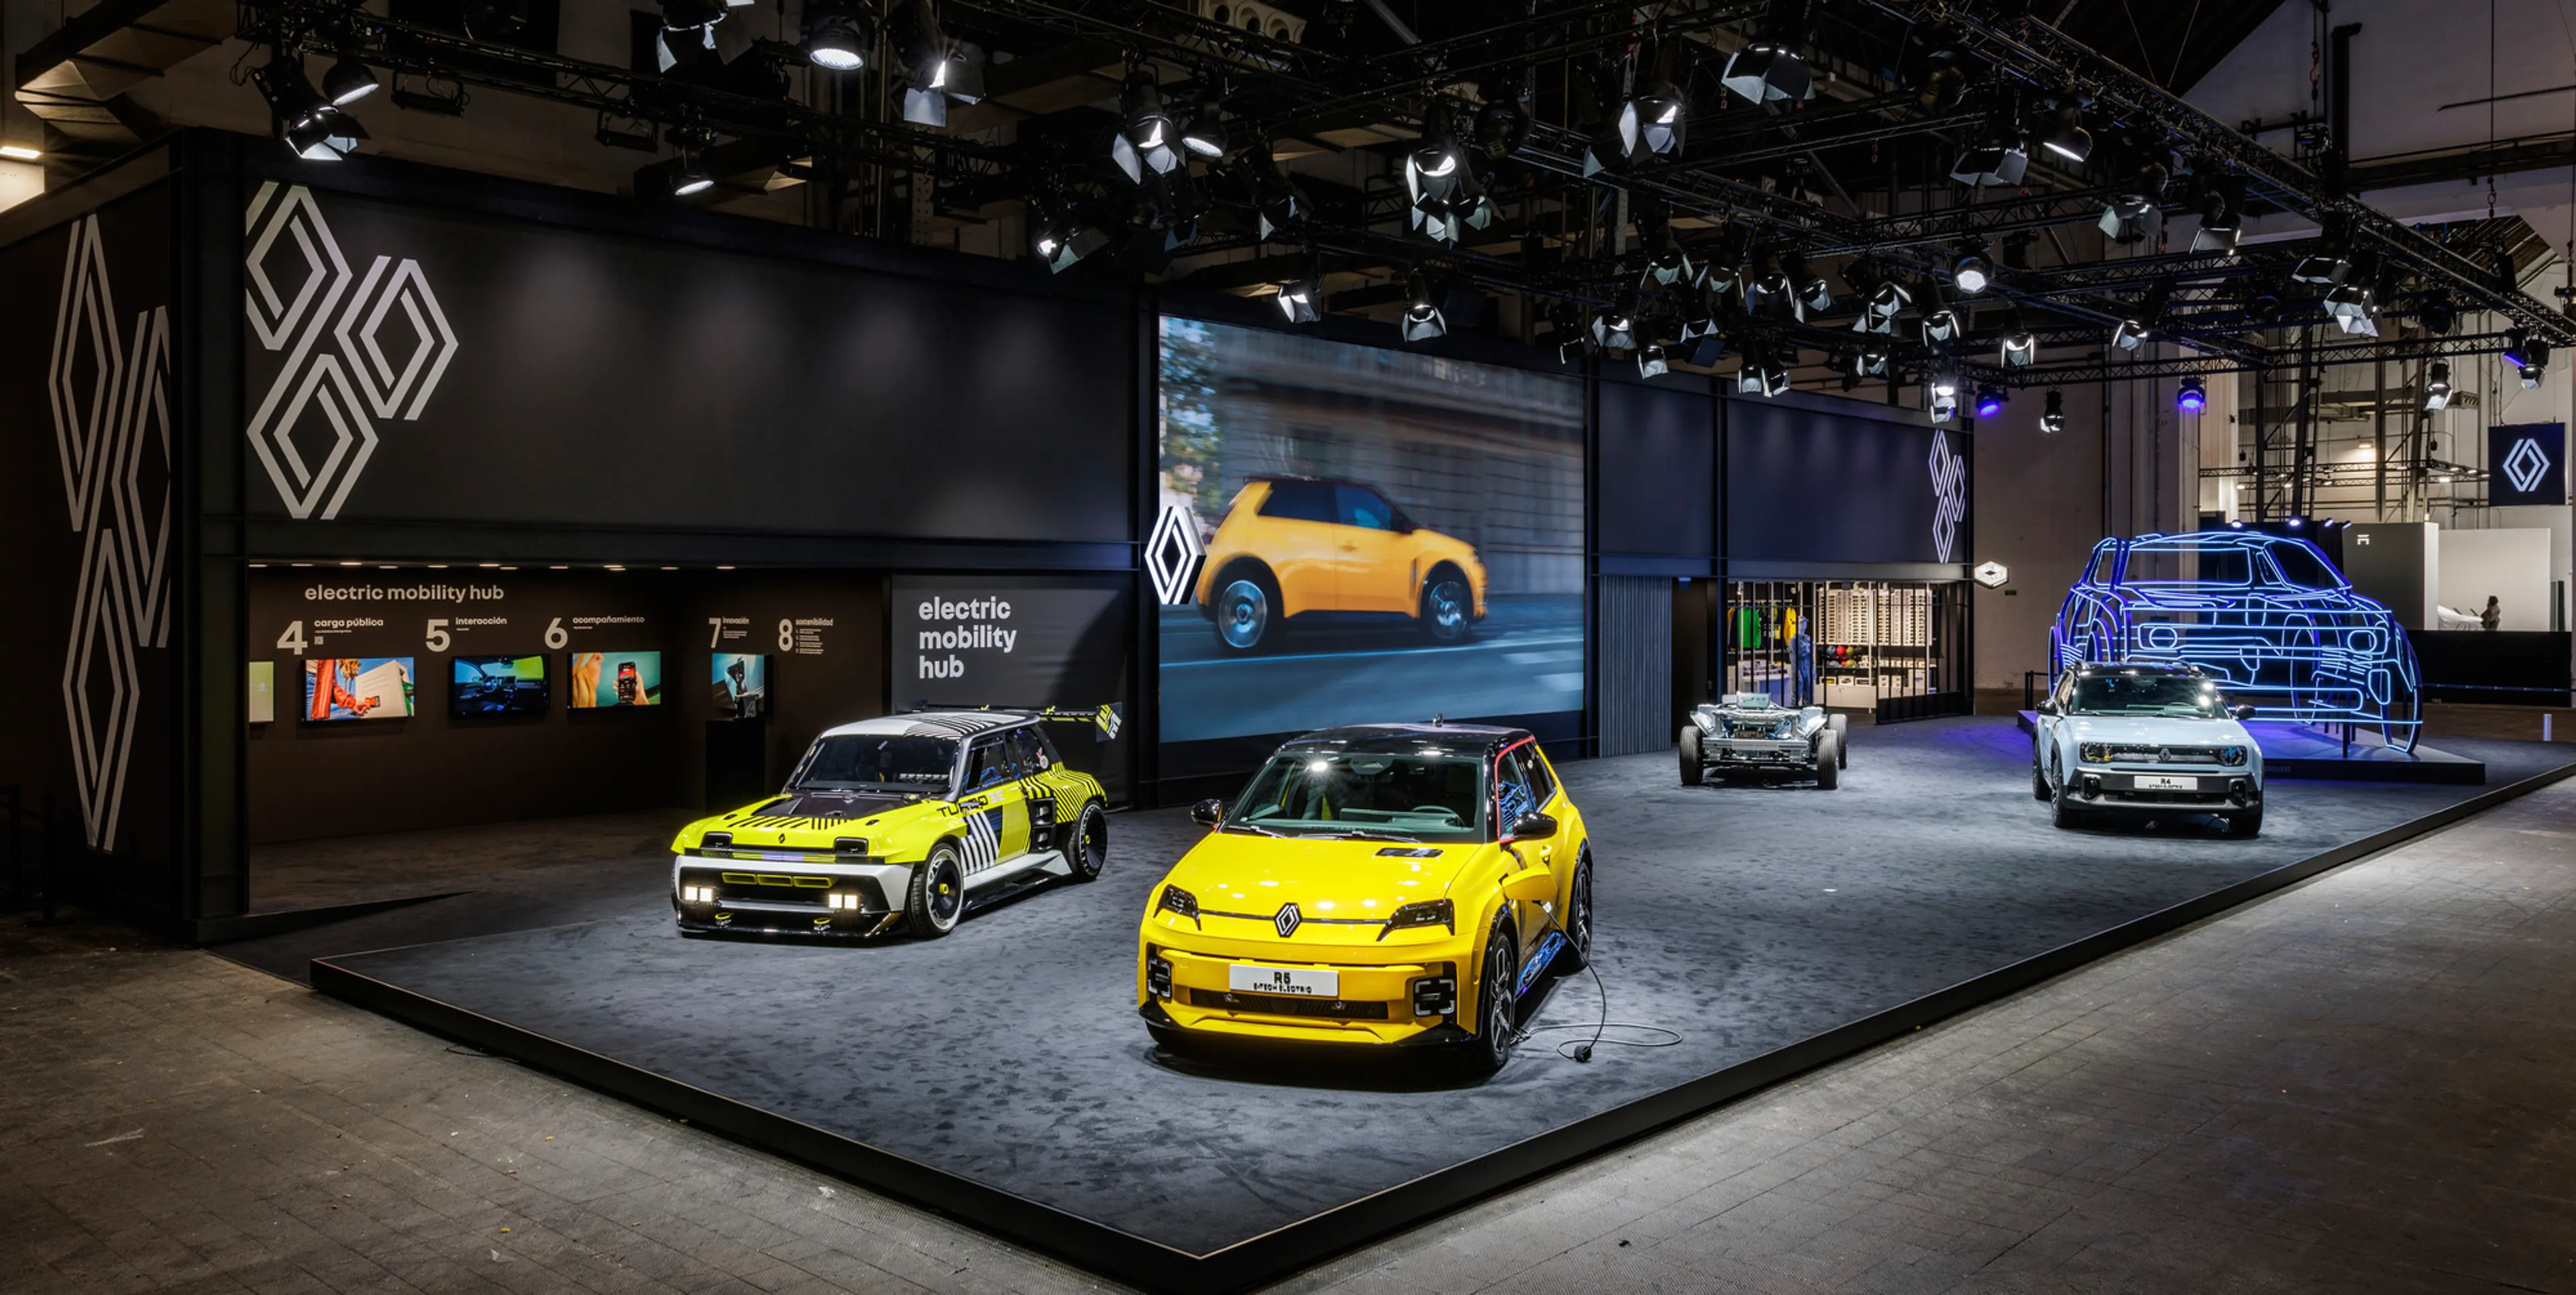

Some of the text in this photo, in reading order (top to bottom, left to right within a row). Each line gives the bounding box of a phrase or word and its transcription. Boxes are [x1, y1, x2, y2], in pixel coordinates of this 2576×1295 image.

[305, 584, 504, 603] electric mobility hub
[572, 615, 645, 625] acompañamiento
[918, 596, 1011, 621] electric
[314, 617, 384, 628] carga pública
[425, 619, 451, 652] 5
[544, 617, 568, 650] 6
[708, 617, 721, 649] 7
[778, 618, 794, 652] 8
[276, 620, 309, 656] 4
[919, 625, 1017, 653] mobility
[919, 654, 965, 679] hub
[1274, 972, 1291, 985] R5
